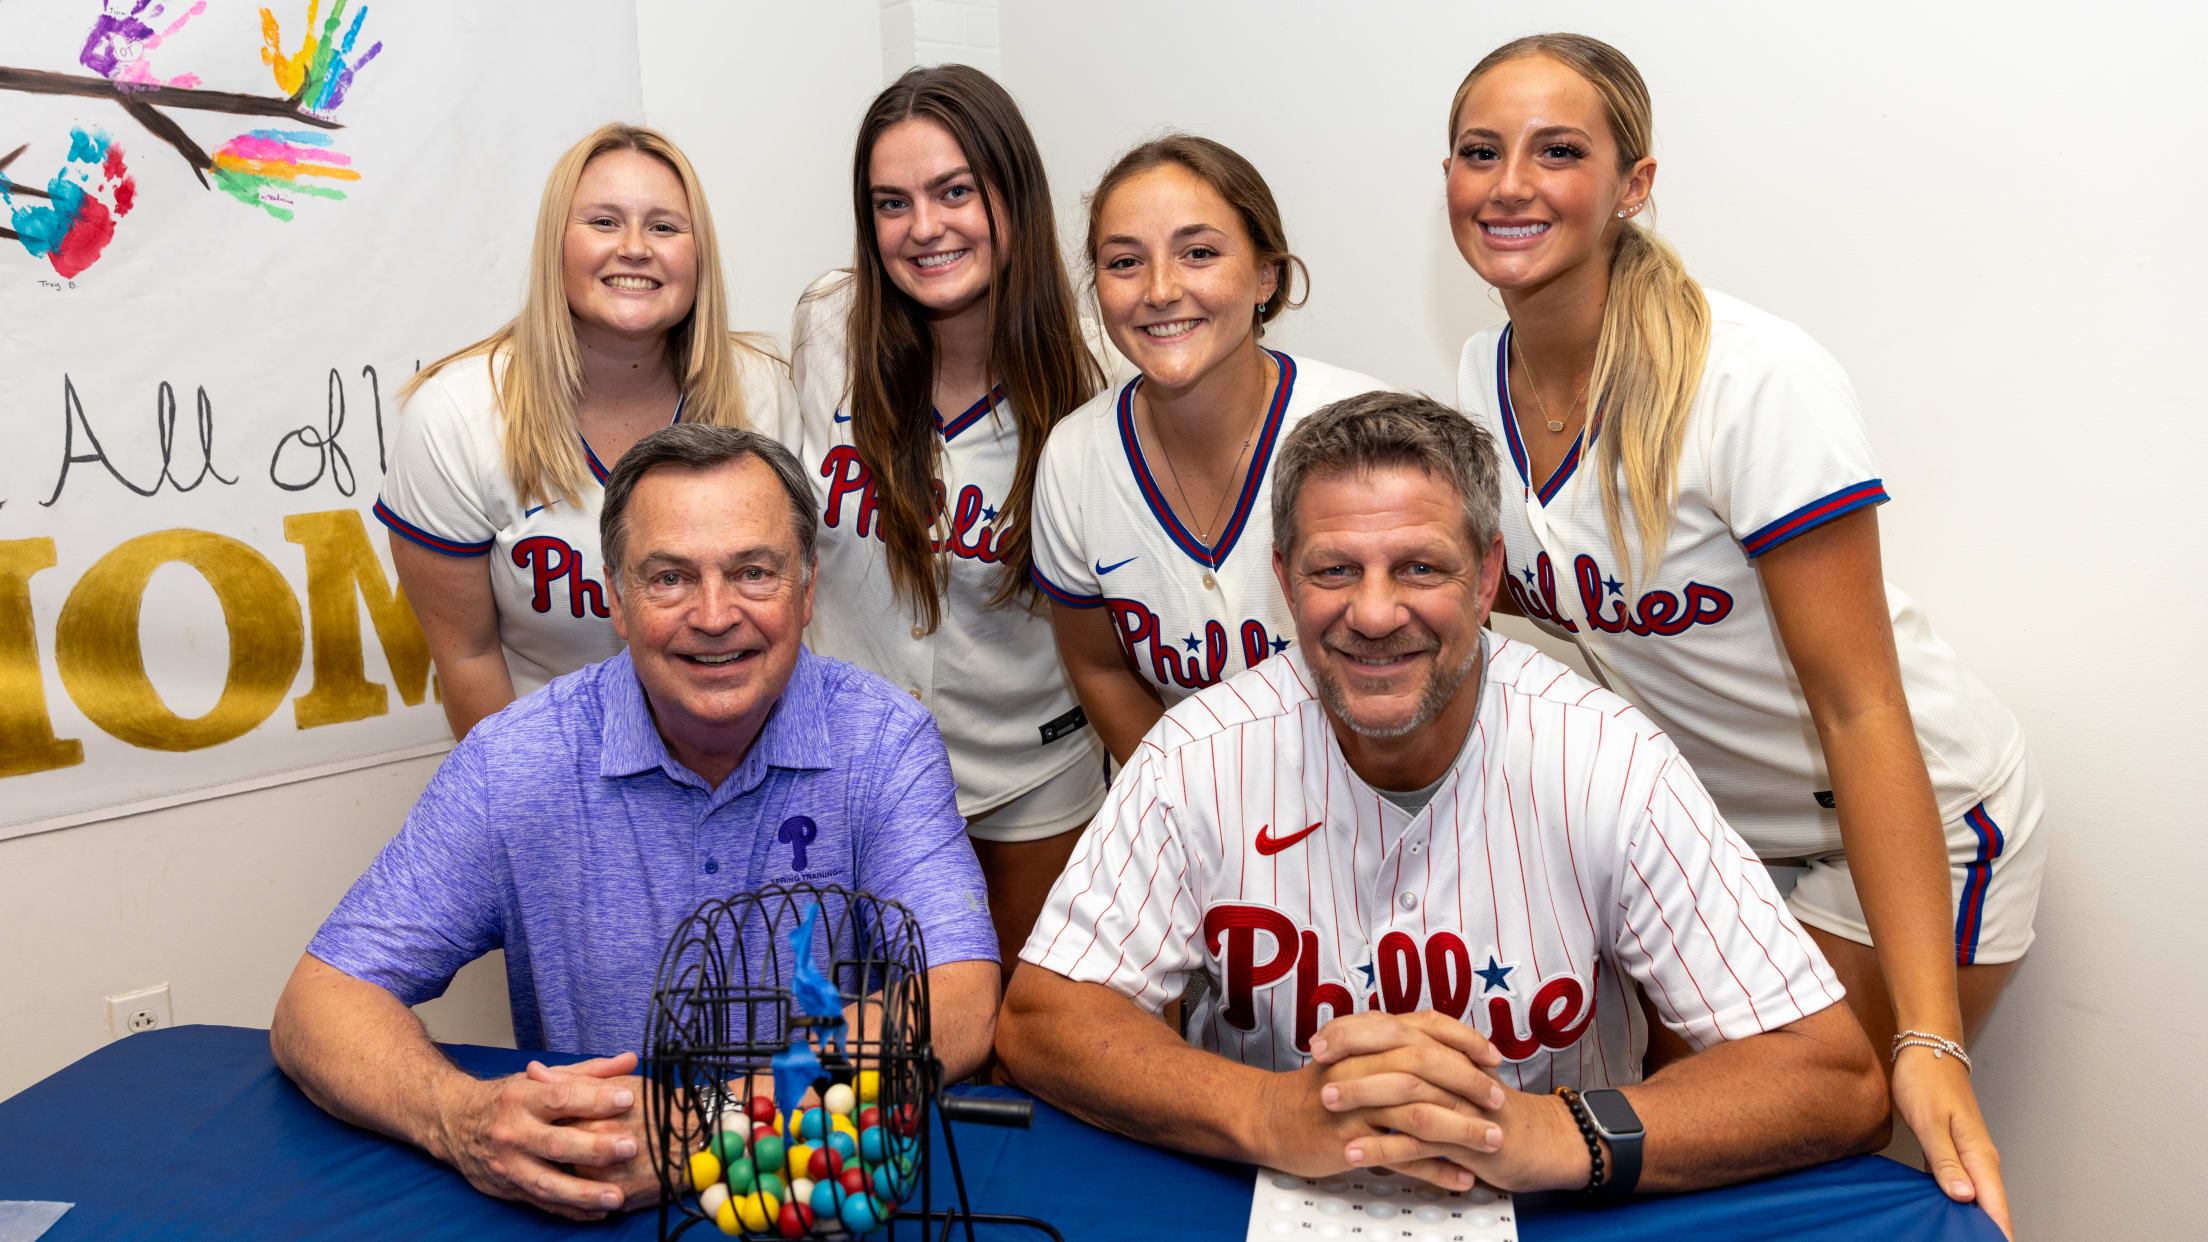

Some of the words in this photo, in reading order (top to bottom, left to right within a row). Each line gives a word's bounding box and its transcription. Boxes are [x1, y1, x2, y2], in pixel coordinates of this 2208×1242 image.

[38, 373, 239, 507] All
[270, 368, 356, 498] of
[778, 816, 817, 872] P
[770, 875, 800, 885] SPRING
[801, 869, 839, 881] TRAINING
